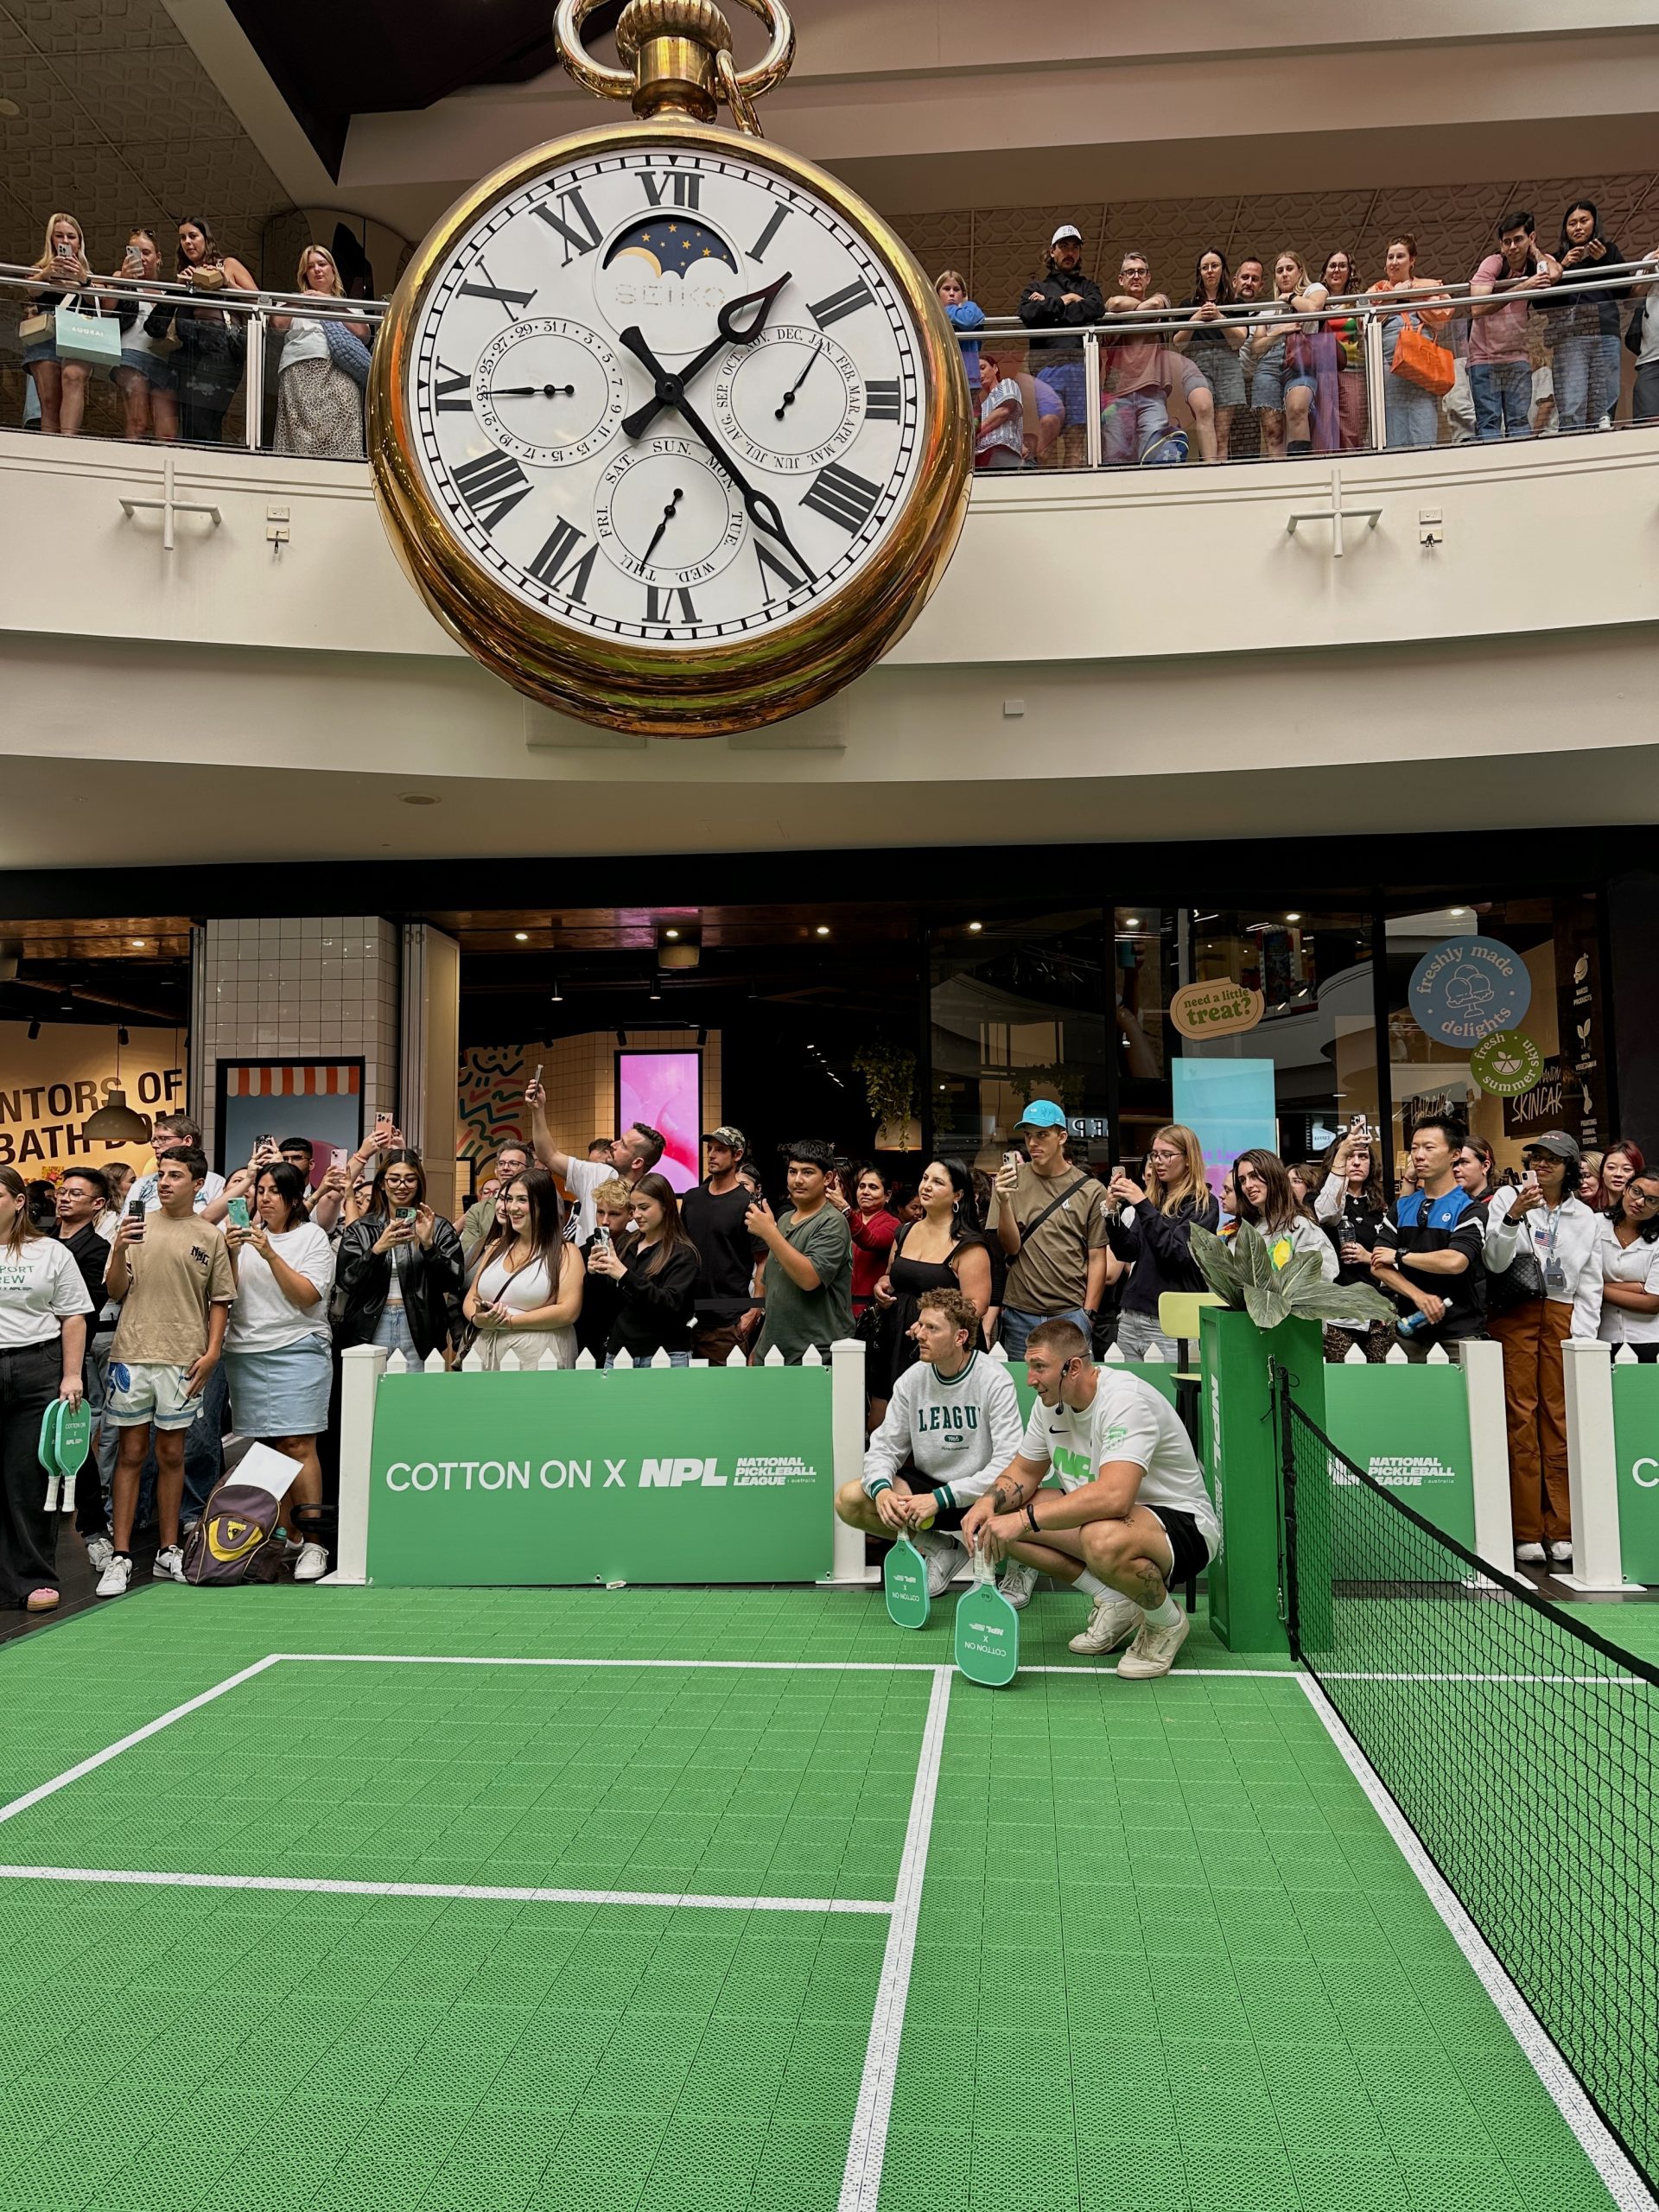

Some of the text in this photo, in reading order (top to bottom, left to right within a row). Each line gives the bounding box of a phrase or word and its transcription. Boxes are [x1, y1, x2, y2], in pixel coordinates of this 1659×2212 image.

[529, 185, 604, 268] XI
[455, 255, 537, 321] X
[615, 284, 726, 307] SEIKO
[805, 274, 877, 332] II
[515, 323, 533, 339] 29
[543, 321, 556, 333] 31
[562, 322, 567, 334] 1
[492, 336, 508, 354] 27
[584, 334, 594, 344] 3
[601, 353, 613, 363] 5
[479, 358, 494, 375] 25
[612, 378, 623, 386] 7
[864, 376, 899, 425] III
[610, 404, 622, 414] 9
[481, 411, 498, 426] 21
[598, 426, 610, 438] 11
[499, 434, 514, 447] 19
[522, 448, 537, 460] 17
[551, 450, 564, 461] 15
[596, 440, 743, 582] SUN. MON. TUE. WED. THU. FRI. SAT.
[753, 537, 808, 606] V
[1417, 946, 1514, 994] freshly made
[1184, 995, 1211, 1008] need
[1222, 988, 1249, 1001] little
[1186, 997, 1251, 1026] treat?
[1440, 1007, 1511, 1039] delights
[1474, 1033, 1505, 1060] fresh
[1482, 1039, 1540, 1091] summer skin
[137, 1068, 183, 1104] OF
[0, 1275, 25, 1284] EW
[918, 1406, 980, 1433] LEAGU
[1211, 1373, 1221, 1469] NPL
[737, 1457, 804, 1467] NATIONAL
[1370, 1457, 1442, 1466] NATIONAL
[385, 1458, 728, 1491] COTTON ON X NPL
[735, 1466, 817, 1477] PICKLEBALL
[1368, 1466, 1455, 1477] PICKLEBALL
[1632, 1458, 1659, 1487] C
[734, 1476, 786, 1486] LEAGUE
[1374, 1477, 1422, 1485] EAGUE
[977, 1646, 1007, 1656] COTTON
